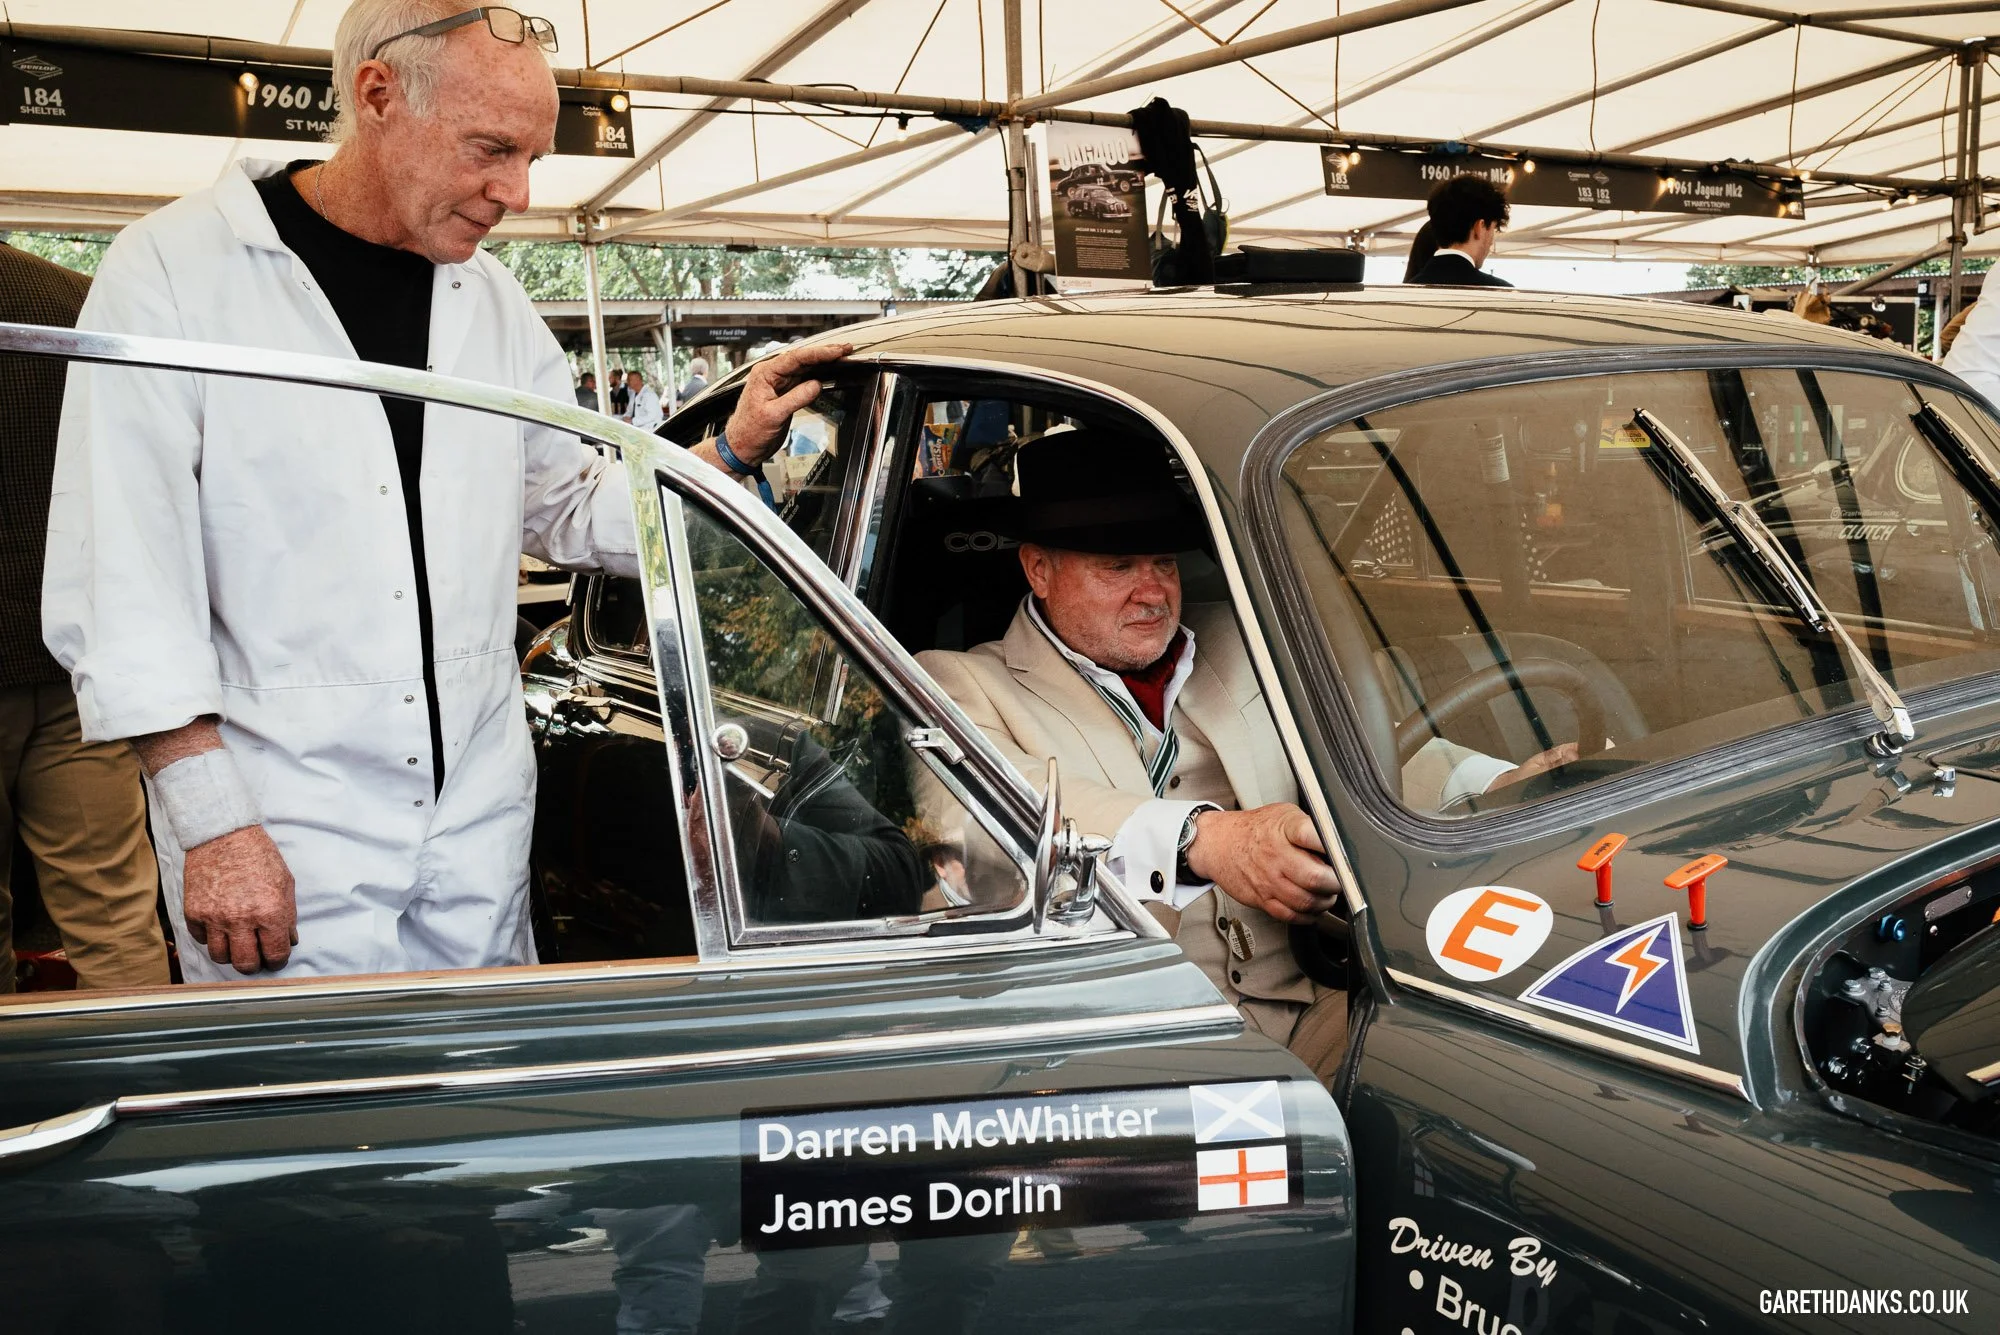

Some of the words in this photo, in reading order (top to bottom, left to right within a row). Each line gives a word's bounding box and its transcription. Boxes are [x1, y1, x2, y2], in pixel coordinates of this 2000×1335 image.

[24, 86, 63, 107] 184
[247, 84, 312, 109] 1960
[20, 105, 66, 116] SHELTER
[285, 119, 304, 130] ST
[598, 125, 626, 142] 184
[595, 141, 628, 150] SHELTER
[1331, 171, 1348, 184] 183
[1421, 164, 1450, 180] 1960
[1578, 186, 1592, 197] 183
[1596, 188, 1610, 199] 182
[1668, 180, 1692, 195] 1961
[1695, 181, 1723, 199] Jaguar
[1725, 183, 1743, 198] Mk2
[1838, 524, 1898, 541] CLUTCH
[1440, 889, 1542, 973] E
[758, 1121, 917, 1163] Darren
[932, 1104, 1158, 1151] McWhirter
[759, 1192, 914, 1235] James
[927, 1176, 1062, 1222] Dorlin
[1388, 1216, 1494, 1270] Driven
[1507, 1236, 1558, 1289] By
